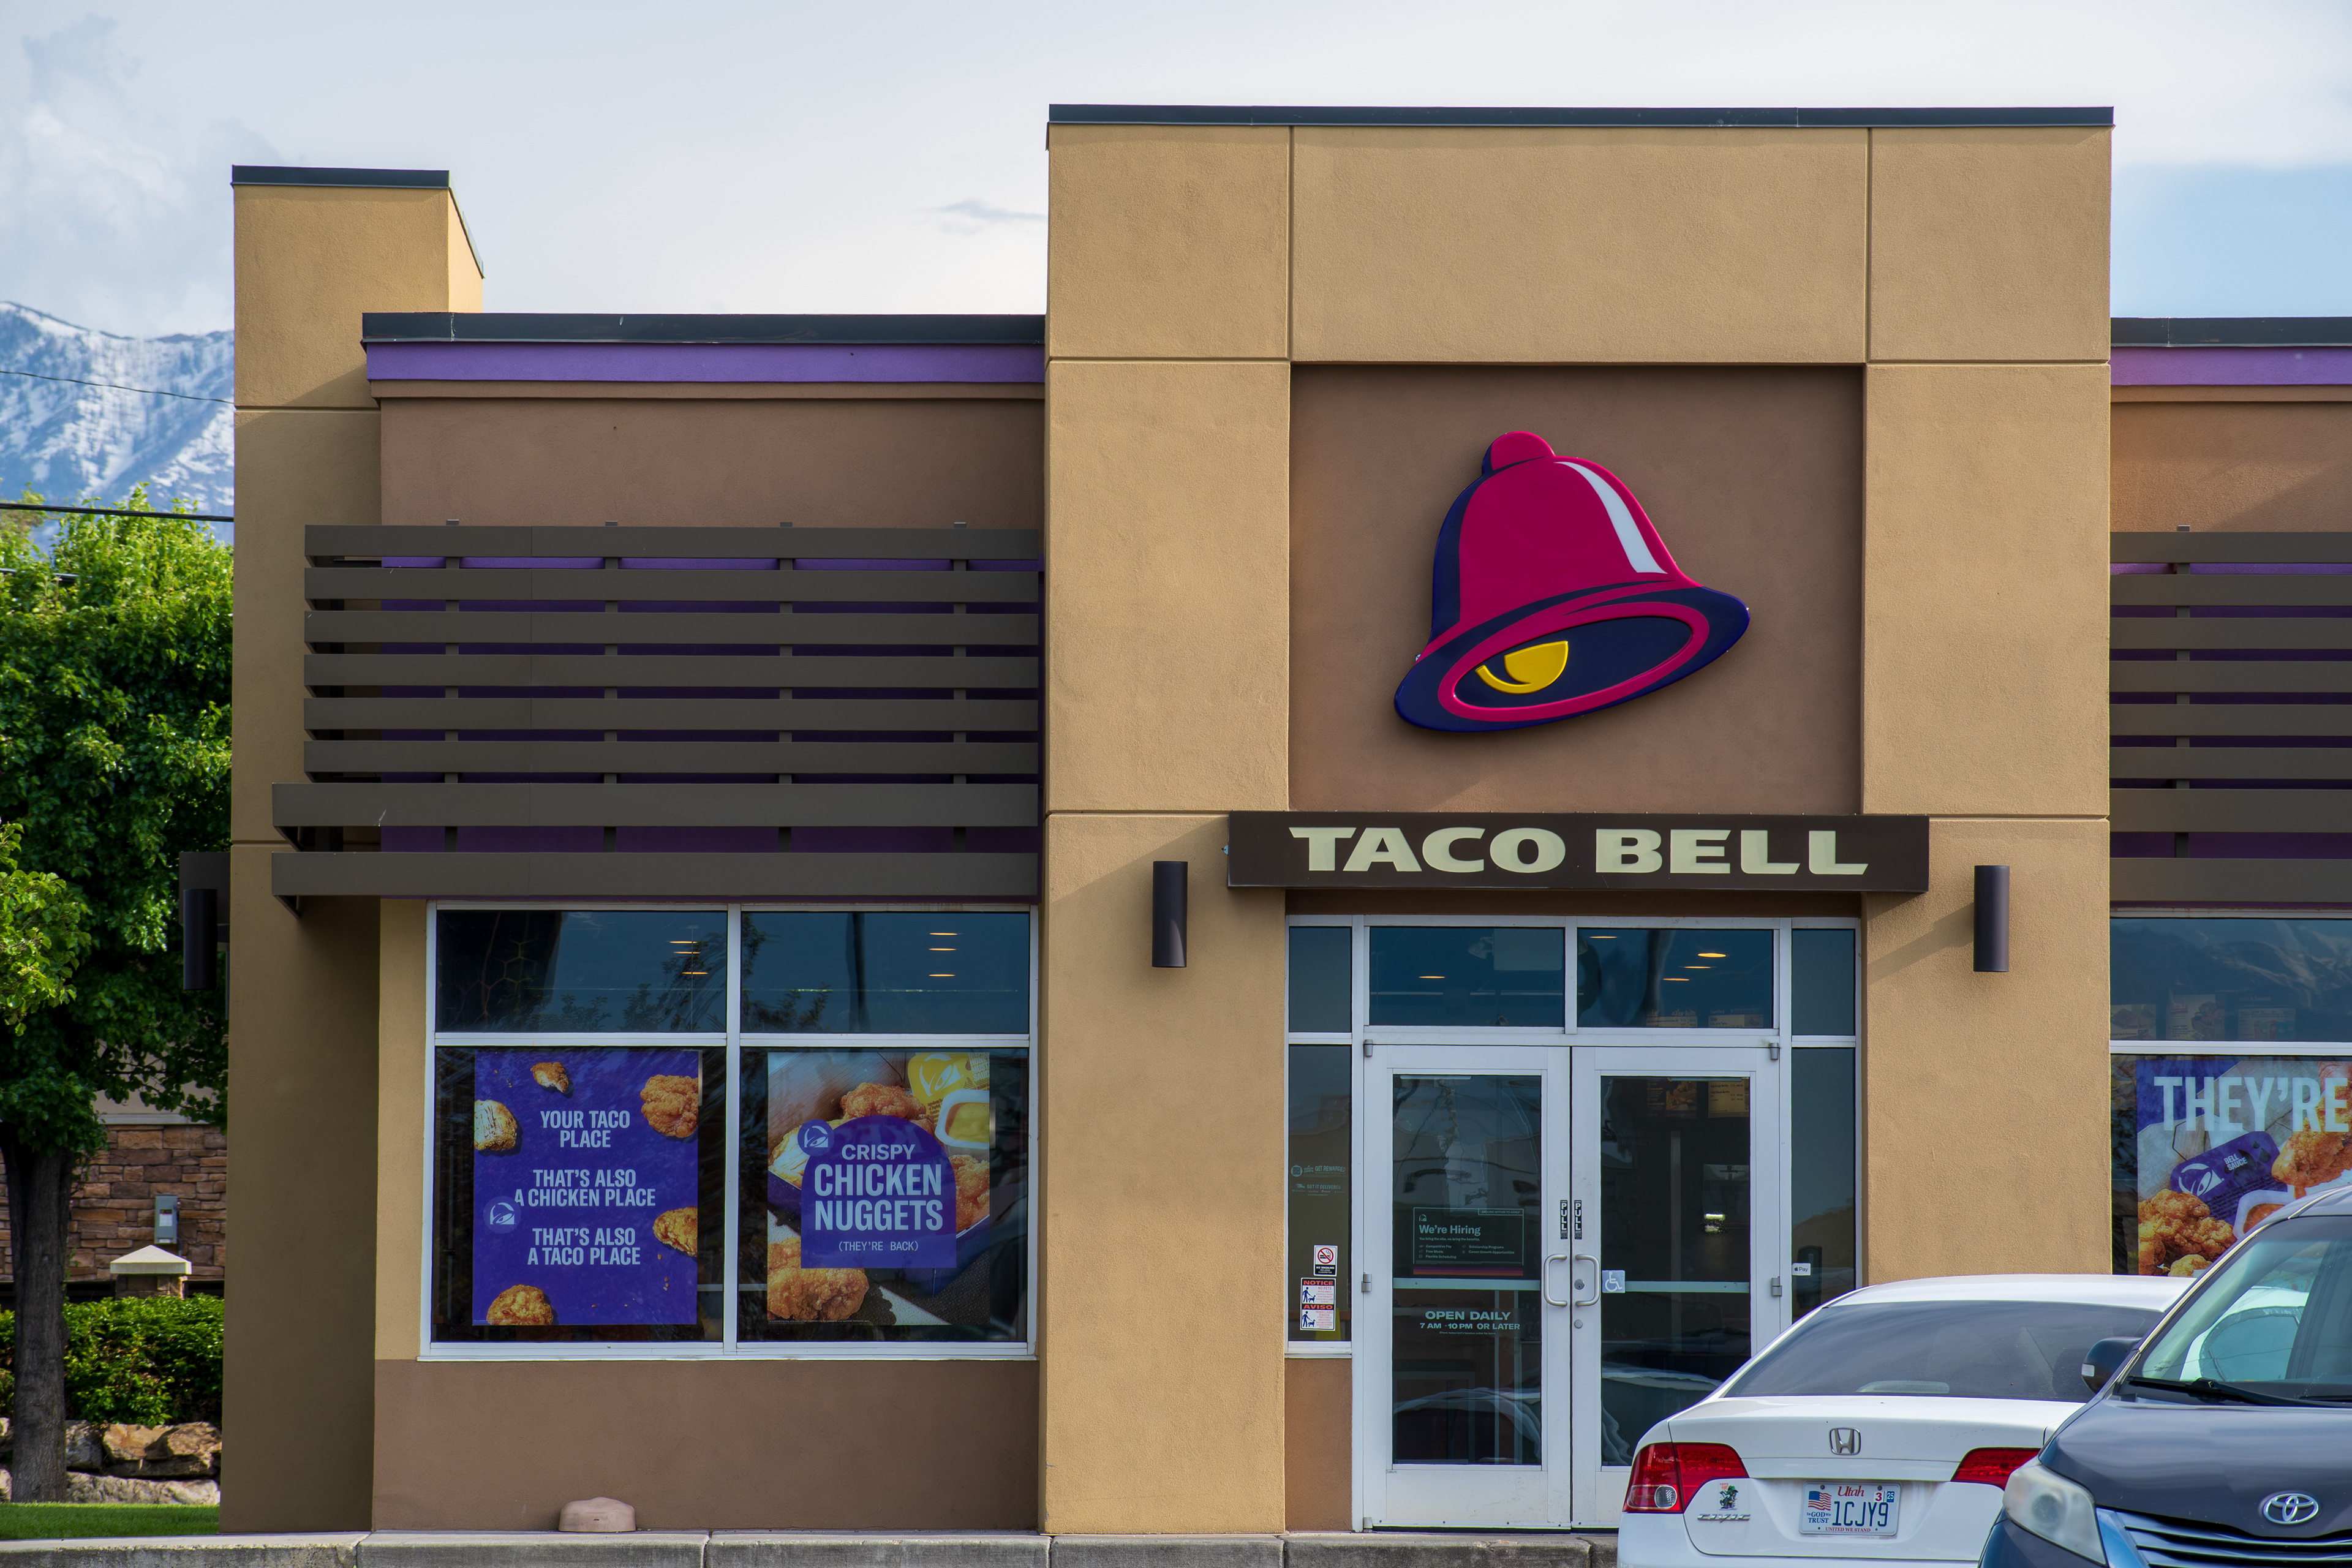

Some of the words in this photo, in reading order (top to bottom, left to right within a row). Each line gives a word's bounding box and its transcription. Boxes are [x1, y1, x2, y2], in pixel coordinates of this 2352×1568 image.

[1289, 826, 1566, 873] TACO
[1596, 828, 1869, 875] BELL
[971, 1062, 990, 1074] MUST
[2154, 1076, 2349, 1132] THEY'RE
[540, 1110, 584, 1128] YOUR
[589, 1110, 630, 1128] TACO
[560, 1130, 611, 1148] PLACE
[842, 1144, 915, 1160] CRISPY
[2223, 1153, 2239, 1164] BELL
[2227, 1157, 2248, 1170] SAUCE
[533, 1169, 590, 1187] THAT'S
[595, 1169, 636, 1187] ALSO
[814, 1164, 941, 1196] CHICKEN
[514, 1189, 524, 1207] A
[528, 1188, 600, 1207] CHICKEN
[605, 1188, 656, 1207] PLACE
[815, 1199, 943, 1231] NUGGETS
[532, 1227, 589, 1246] THAT'S
[594, 1227, 636, 1246] ALSO
[1419, 1224, 1447, 1234] We're
[1450, 1224, 1481, 1237] Hiring
[839, 1241, 883, 1252] (THEY'RE
[890, 1241, 919, 1252] BACK)
[527, 1247, 538, 1265] A
[541, 1247, 584, 1265] TACO
[590, 1247, 641, 1265] PLACE
[1425, 1311, 1465, 1320] OPEN
[1469, 1311, 1511, 1321] DAILY
[1838, 1485, 1864, 1497] Utah
[1875, 1492, 1882, 1501] 3
[1697, 1513, 1751, 1523] CIVIC
[1832, 1501, 1888, 1527] 1CJY9
